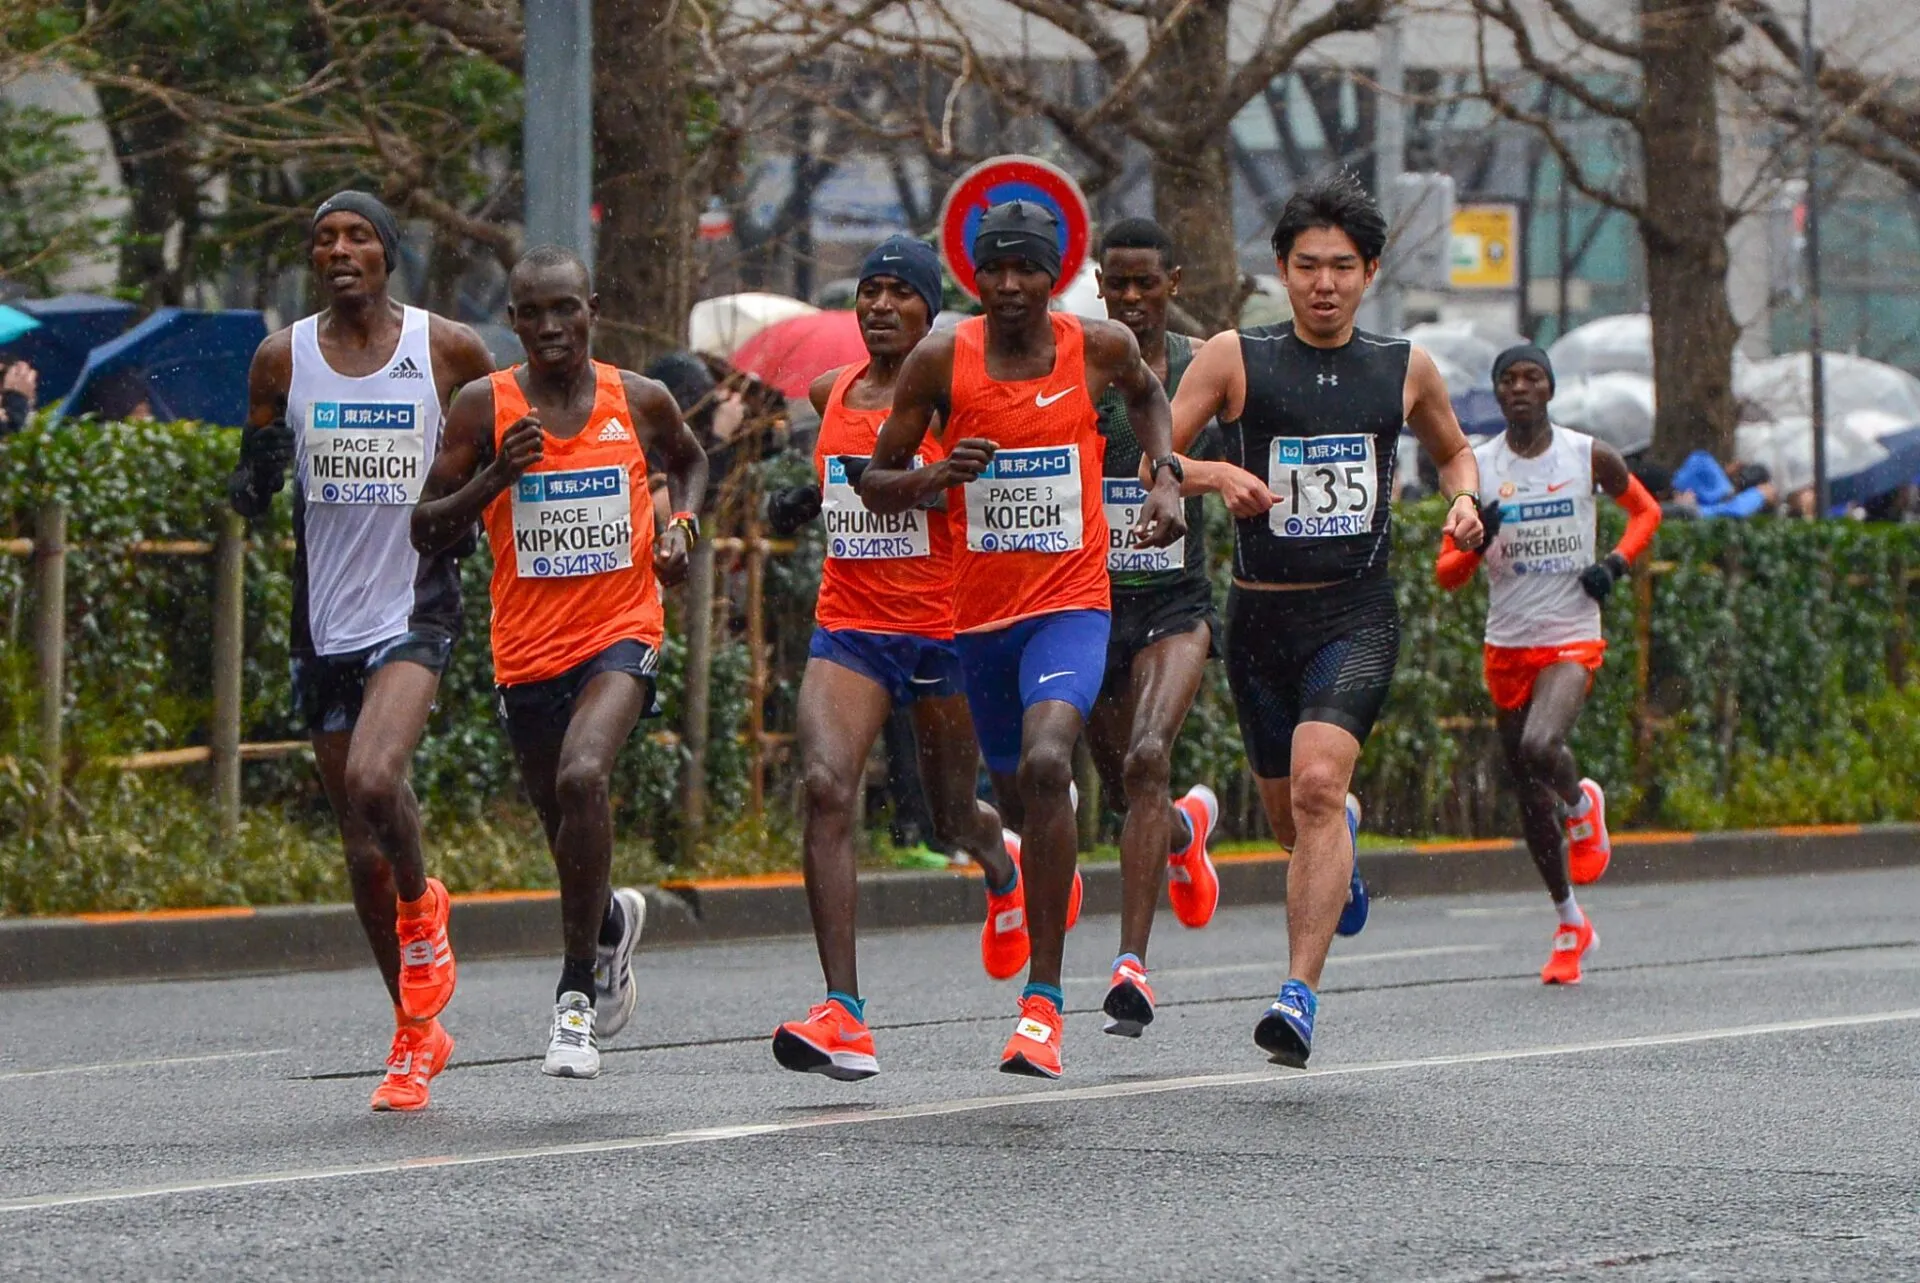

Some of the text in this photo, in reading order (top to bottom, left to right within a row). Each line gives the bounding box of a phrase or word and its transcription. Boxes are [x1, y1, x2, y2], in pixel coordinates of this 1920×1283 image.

[389, 370, 423, 379] adidas
[344, 409, 410, 424] 東京メトロ
[333, 438, 395, 453] PACE 2
[598, 432, 631, 442] adidas
[1307, 443, 1363, 459] 東京メトロ
[313, 455, 416, 478] MENGICH
[999, 455, 1065, 472] 東京メトロ
[341, 483, 407, 503] STARTS
[549, 476, 615, 495] 東京メトロ
[990, 486, 1053, 502] PACE 3
[1111, 486, 1149, 499] 東京メ
[1290, 466, 1368, 515] 135
[540, 507, 602, 526] PACE 1
[827, 510, 919, 533] CHUMBA
[984, 504, 1061, 530] KOECH
[516, 521, 630, 552] KIPKOECH
[848, 537, 913, 557] STARTS
[1500, 534, 1582, 559] KIPKEMBOI
[553, 551, 618, 576] STARTS
